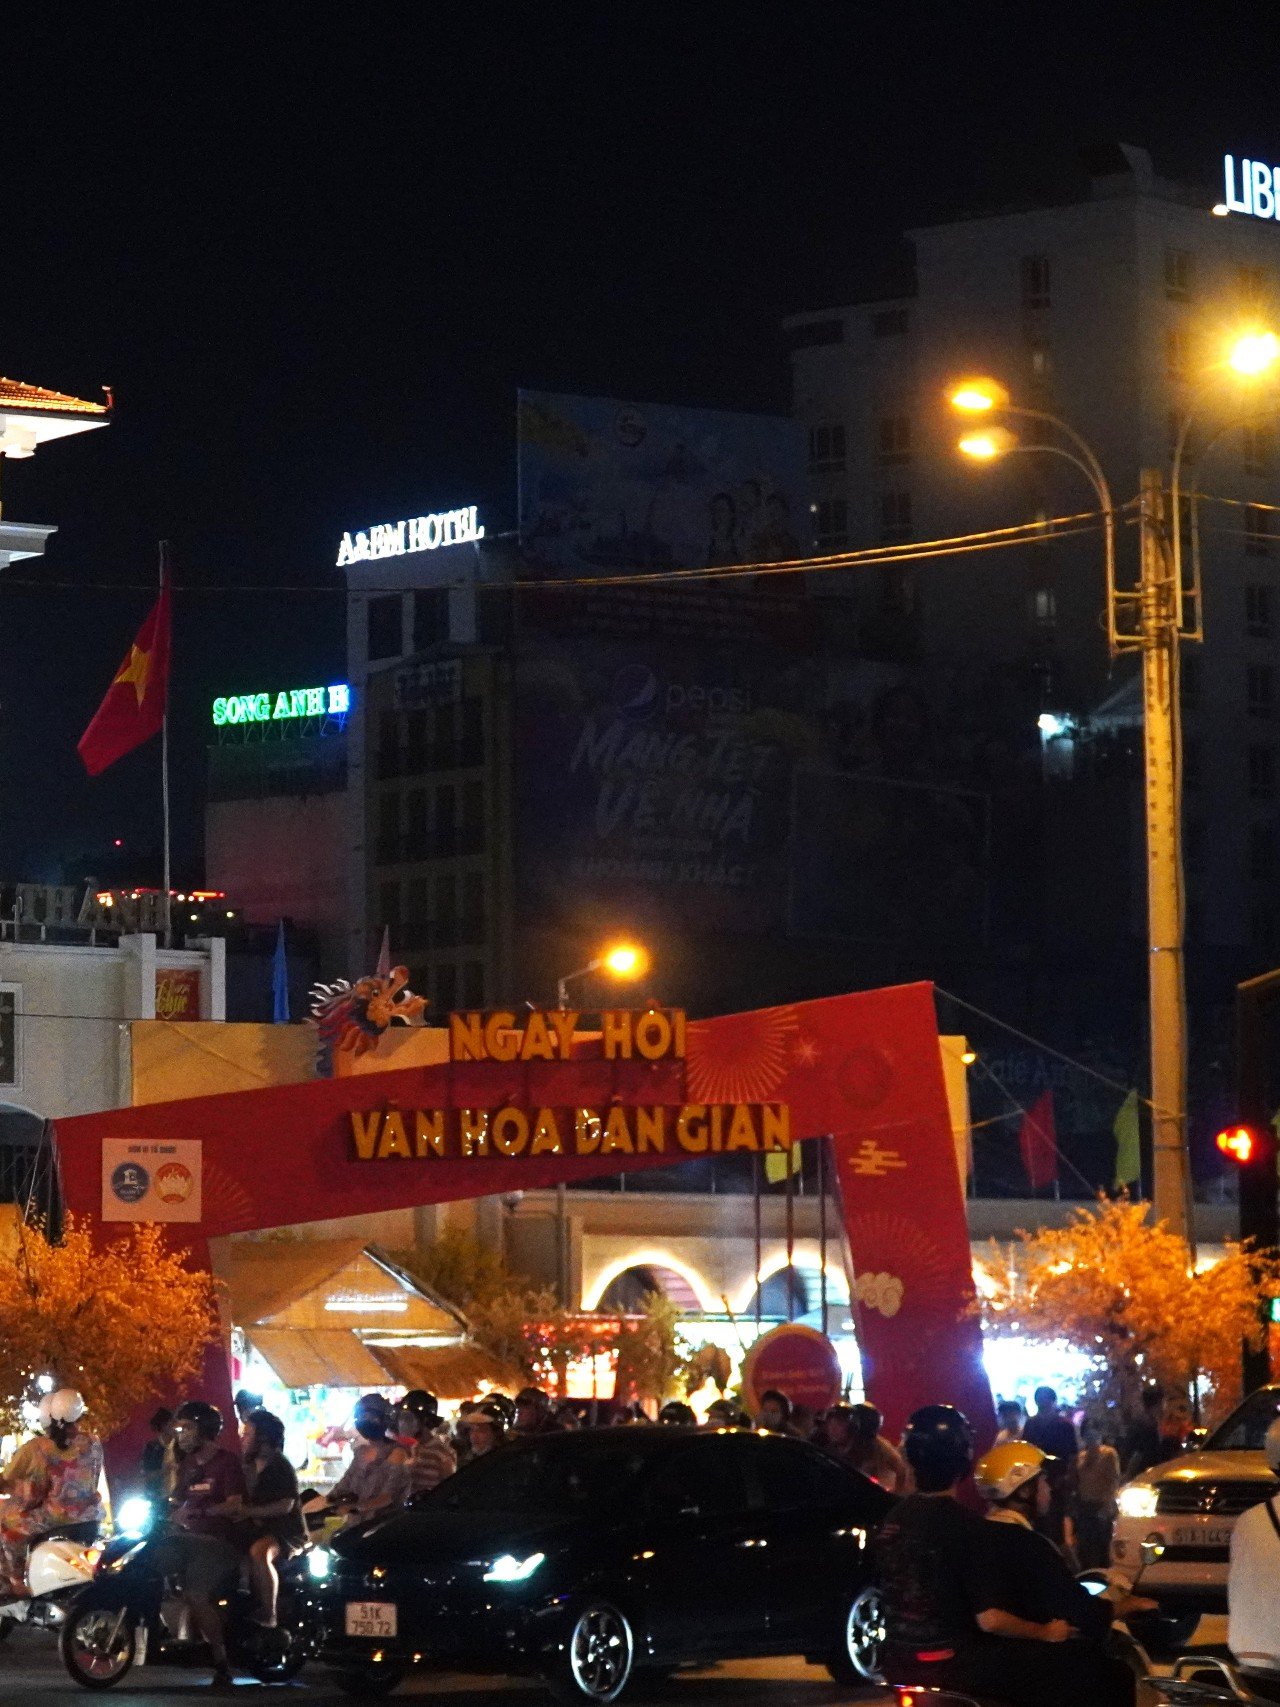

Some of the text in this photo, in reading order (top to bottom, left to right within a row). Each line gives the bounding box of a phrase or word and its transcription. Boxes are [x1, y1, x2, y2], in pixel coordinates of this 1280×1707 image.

[407, 505, 485, 552] HOTEL
[213, 694, 270, 725] SONG
[273, 687, 326, 719] ANH
[676, 1103, 790, 1153] GIAN
[360, 1604, 382, 1620] 51K
